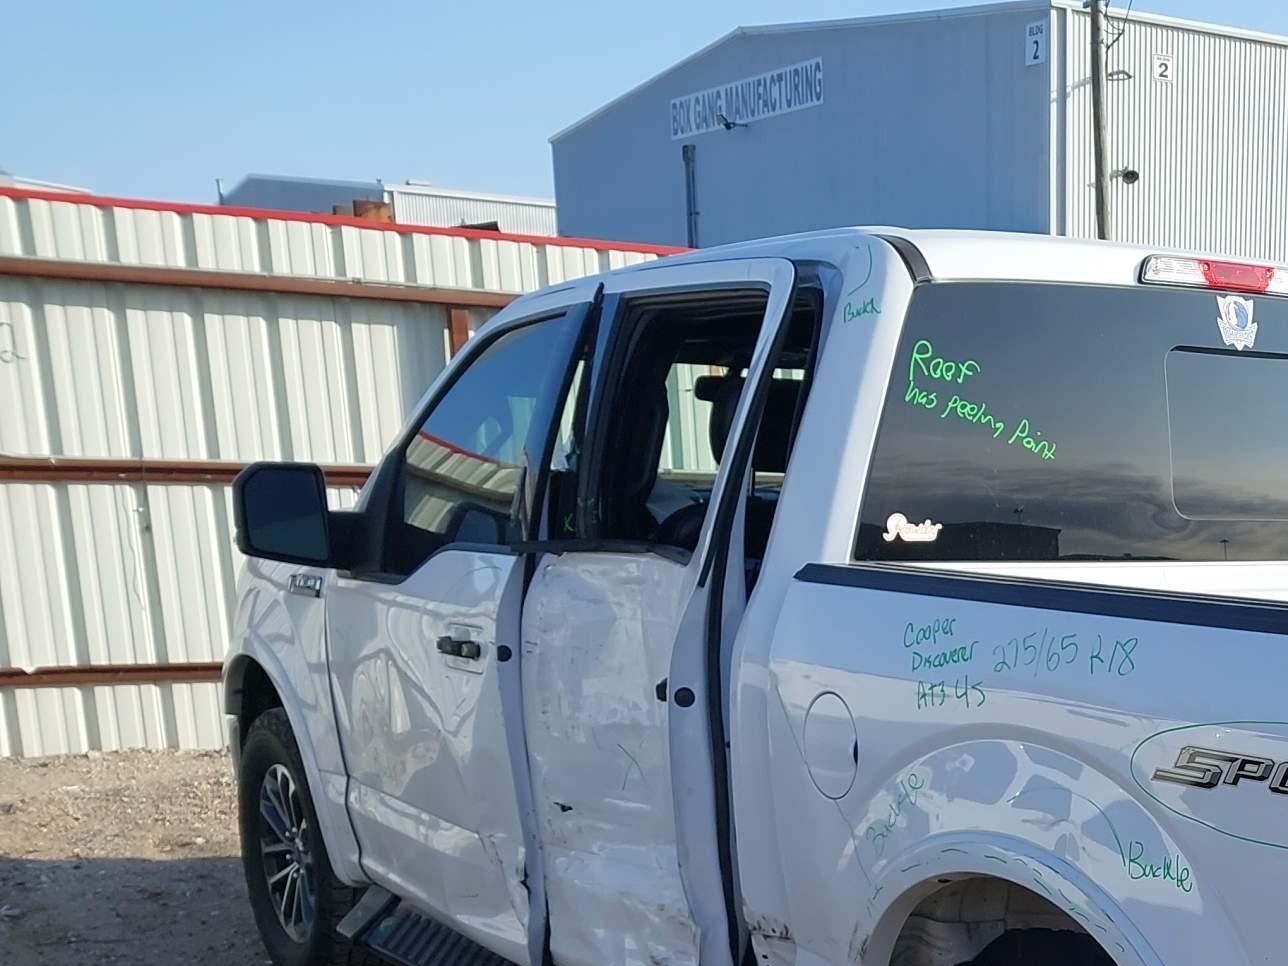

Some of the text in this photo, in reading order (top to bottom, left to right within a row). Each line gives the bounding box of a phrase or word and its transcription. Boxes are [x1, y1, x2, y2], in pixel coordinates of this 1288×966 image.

[1028, 23, 1044, 37] BLDG
[1032, 39, 1040, 60] 2
[1158, 62, 1169, 78] 2
[671, 61, 822, 136] BOX GANG MANUFACTURING
[905, 381, 937, 408] has
[903, 618, 957, 648] Cooper
[1127, 840, 1194, 893] Buckle
